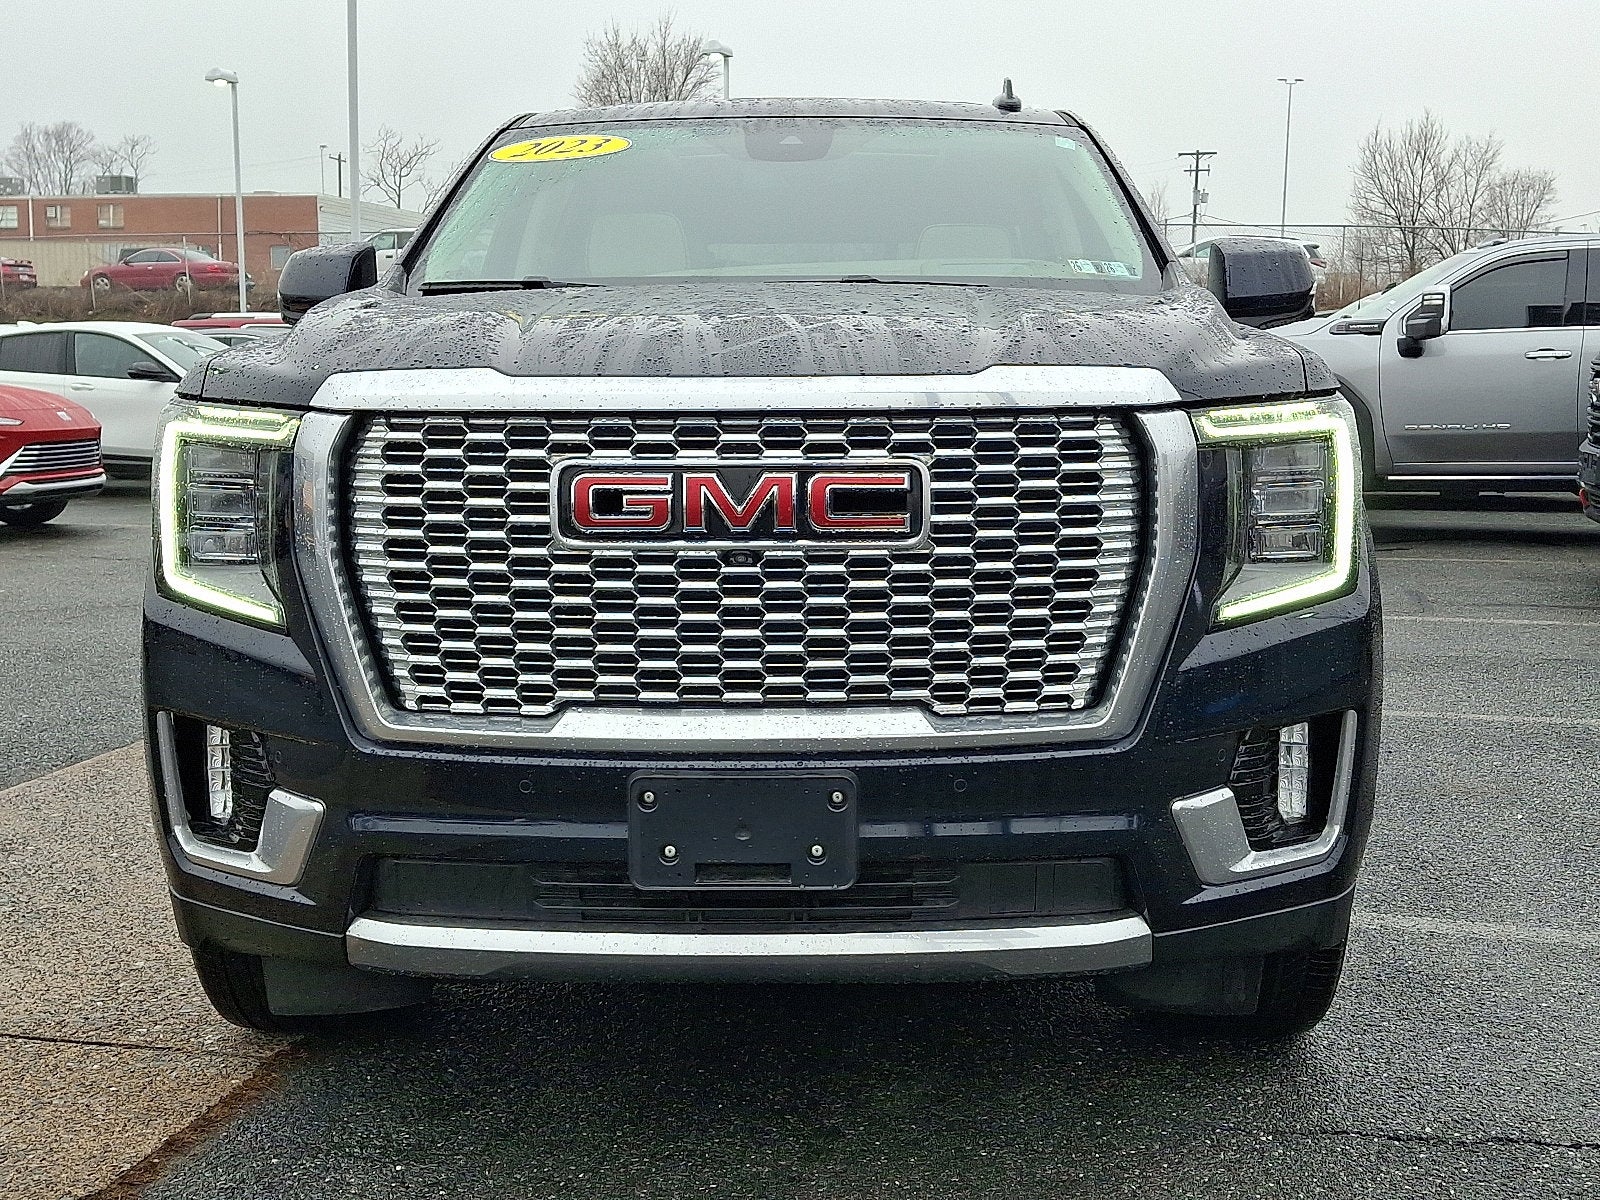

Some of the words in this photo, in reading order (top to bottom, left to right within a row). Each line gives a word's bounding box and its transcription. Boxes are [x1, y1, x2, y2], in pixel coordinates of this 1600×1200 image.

[507, 138, 612, 158] 2023
[1403, 423, 1478, 431] DENALI
[1482, 422, 1511, 430] HD
[571, 472, 911, 533] GMC
